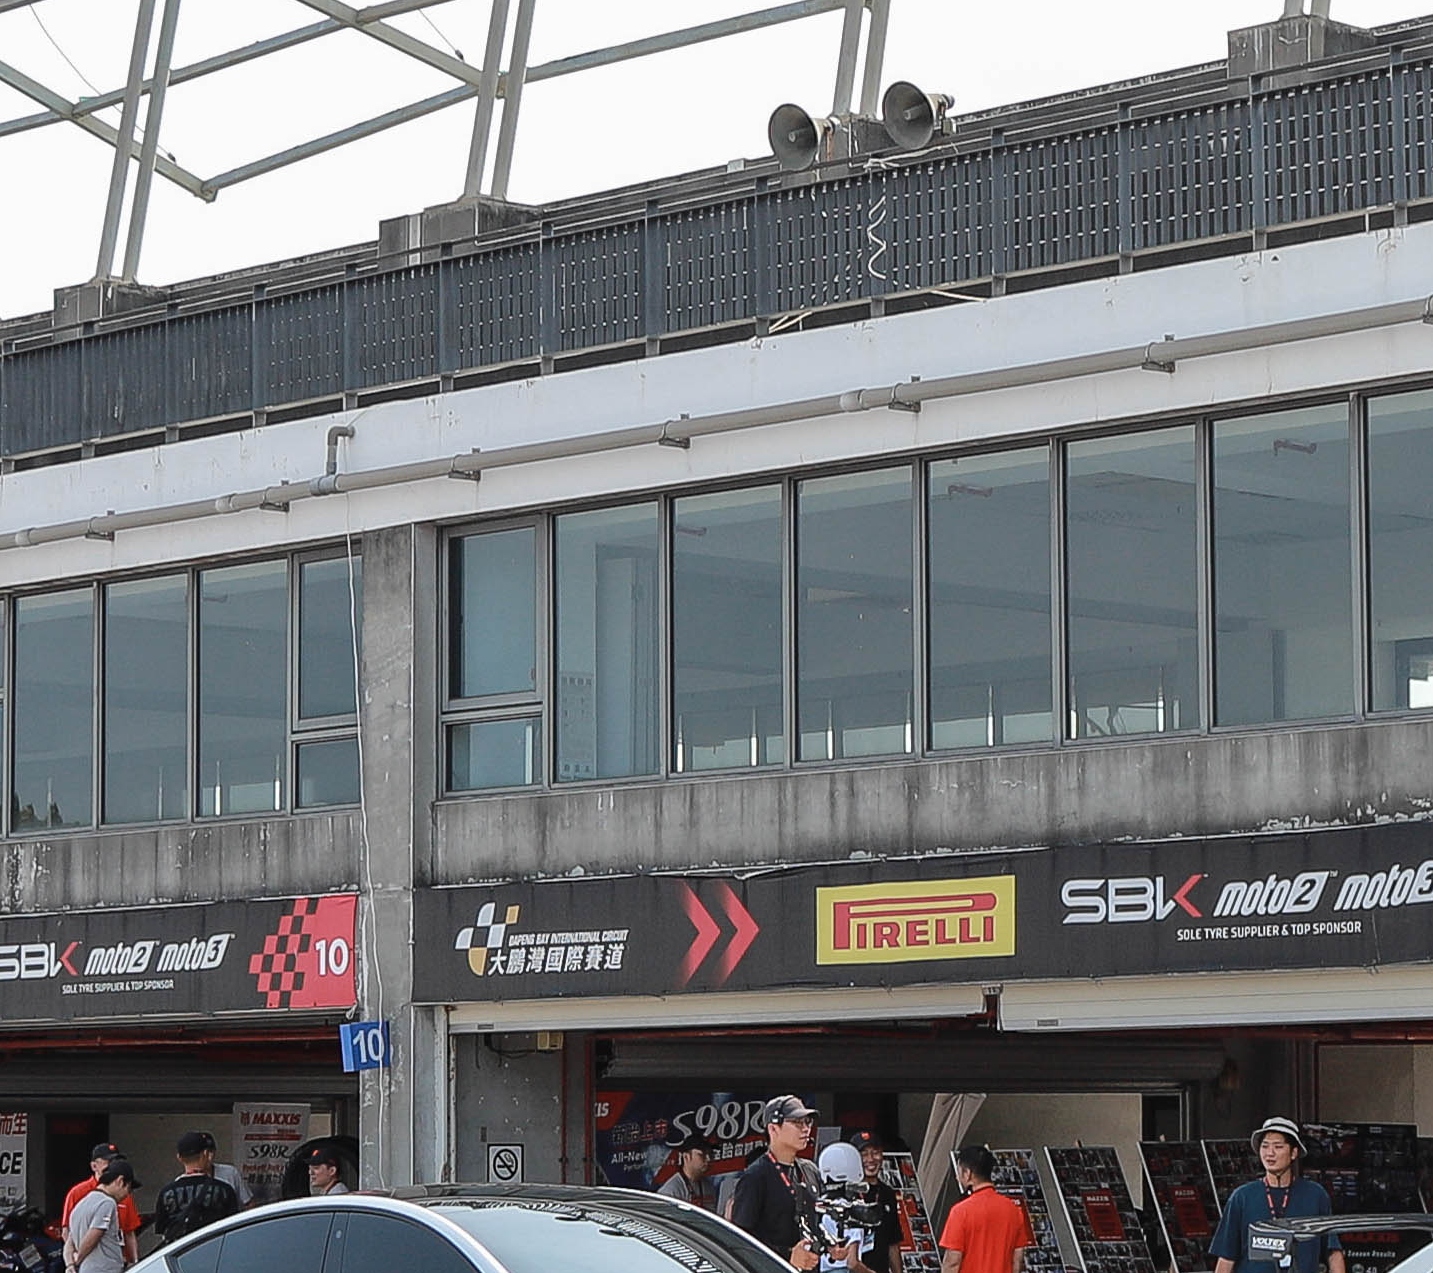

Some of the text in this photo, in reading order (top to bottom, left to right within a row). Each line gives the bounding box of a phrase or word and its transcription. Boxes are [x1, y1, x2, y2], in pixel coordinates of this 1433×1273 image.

[1062, 874, 1203, 924] SBK
[833, 892, 996, 951] PIRELLI
[1177, 920, 1362, 941] SOLE TYRE SUPPLIER & TOP SPONSOR
[315, 937, 349, 978] 10
[353, 1028, 385, 1063] 10
[253, 1112, 301, 1126] MAXXIS
[1251, 1236, 1287, 1248] VOLTEX
